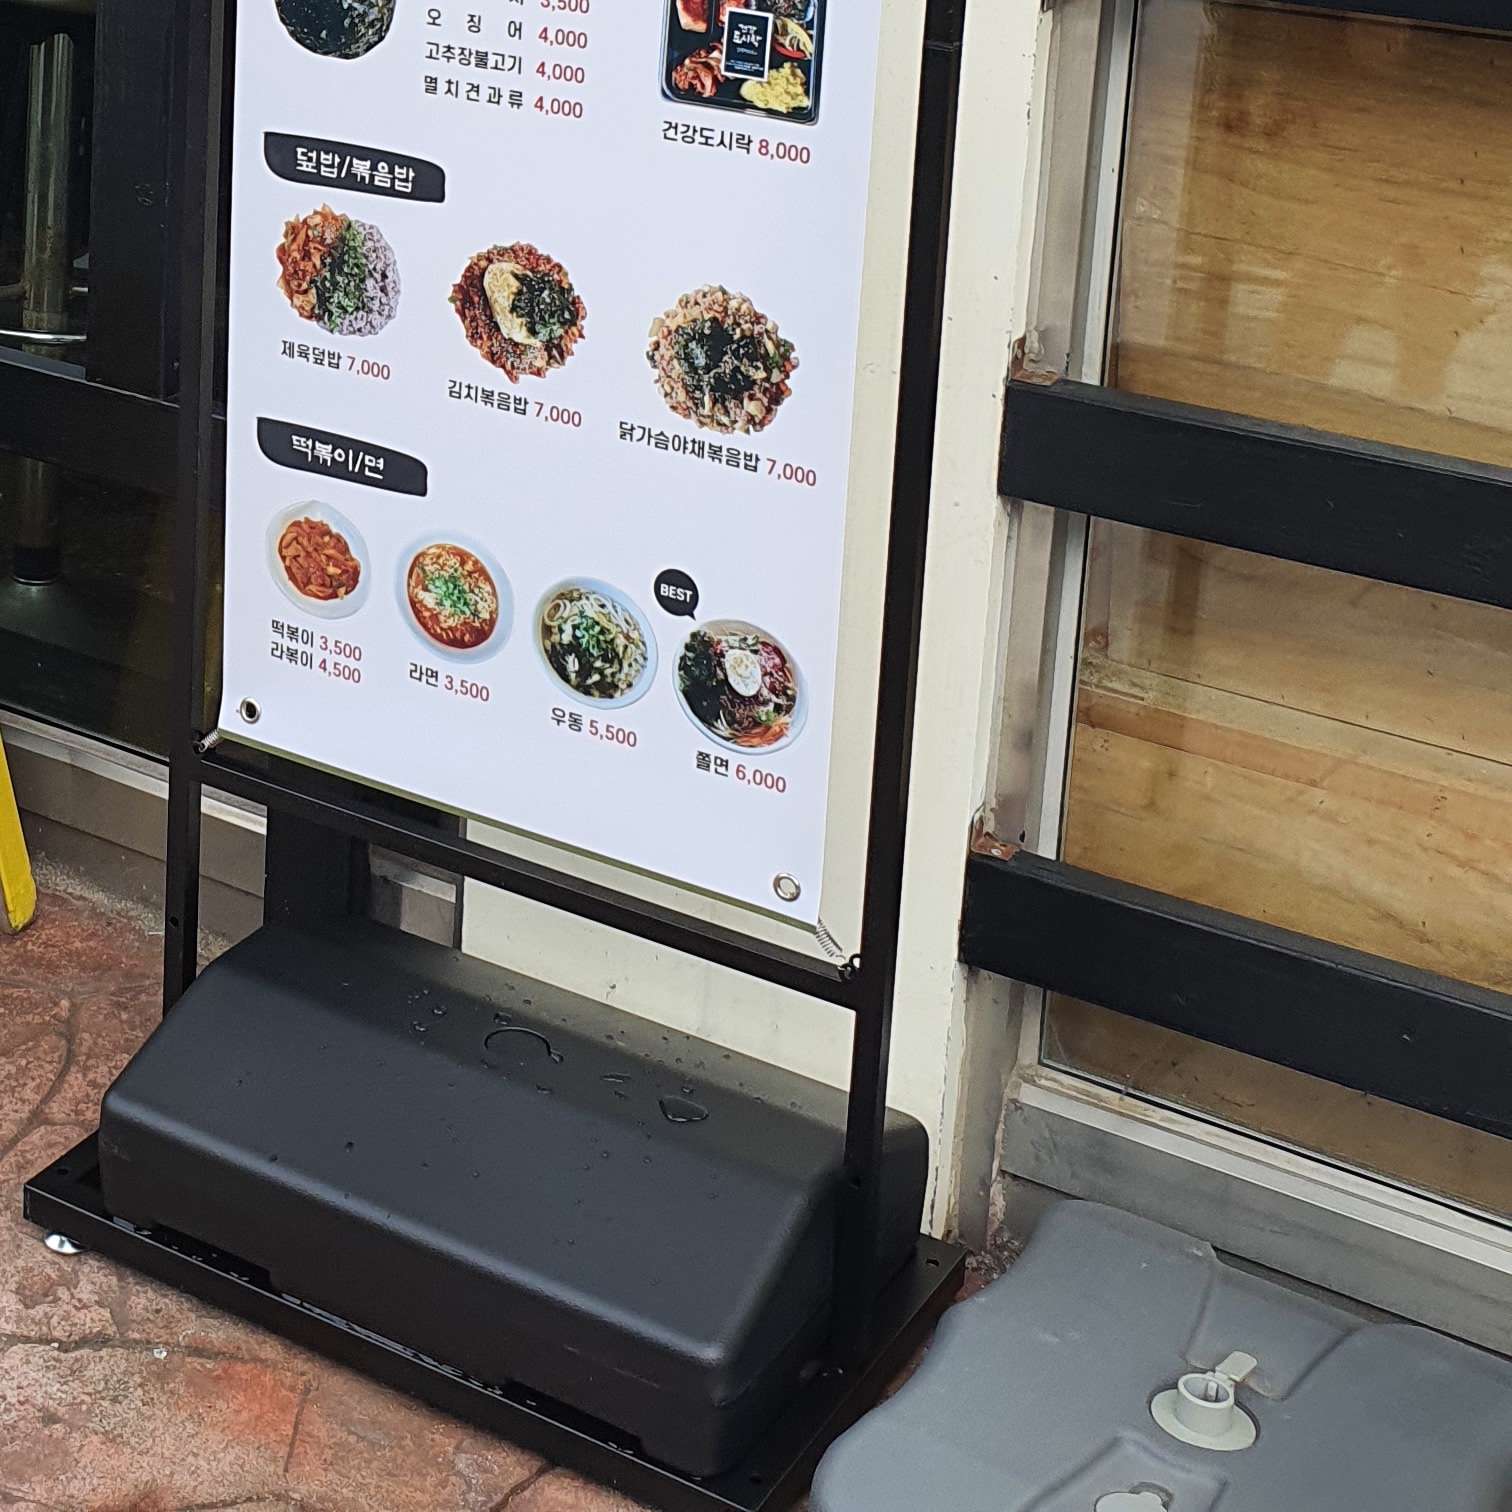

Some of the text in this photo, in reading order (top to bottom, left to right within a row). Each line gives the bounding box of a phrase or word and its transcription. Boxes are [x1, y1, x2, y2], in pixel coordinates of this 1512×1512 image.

[538, 26, 588, 49] 4,000
[425, 41, 585, 84] 고추장불고기 4,000
[533, 95, 584, 119] 4,000
[662, 120, 811, 165] 건강도시락 8,000
[294, 146, 416, 194] 덮밥/볶음밥
[280, 339, 391, 381] 제육덮밥 7,000
[447, 376, 582, 428] 김치볶음밥 7,000
[289, 433, 387, 482] 떡볶이/면
[618, 419, 817, 487] 닭가슴야채볶음밥 7,000
[660, 583, 693, 603] BEST
[270, 619, 363, 663] 떡볶이 3,500
[270, 640, 362, 684] 라볶이 4,500
[409, 662, 490, 702] 라면 3,500
[550, 707, 638, 748] 우동 5,500
[735, 763, 787, 794] 6,000
